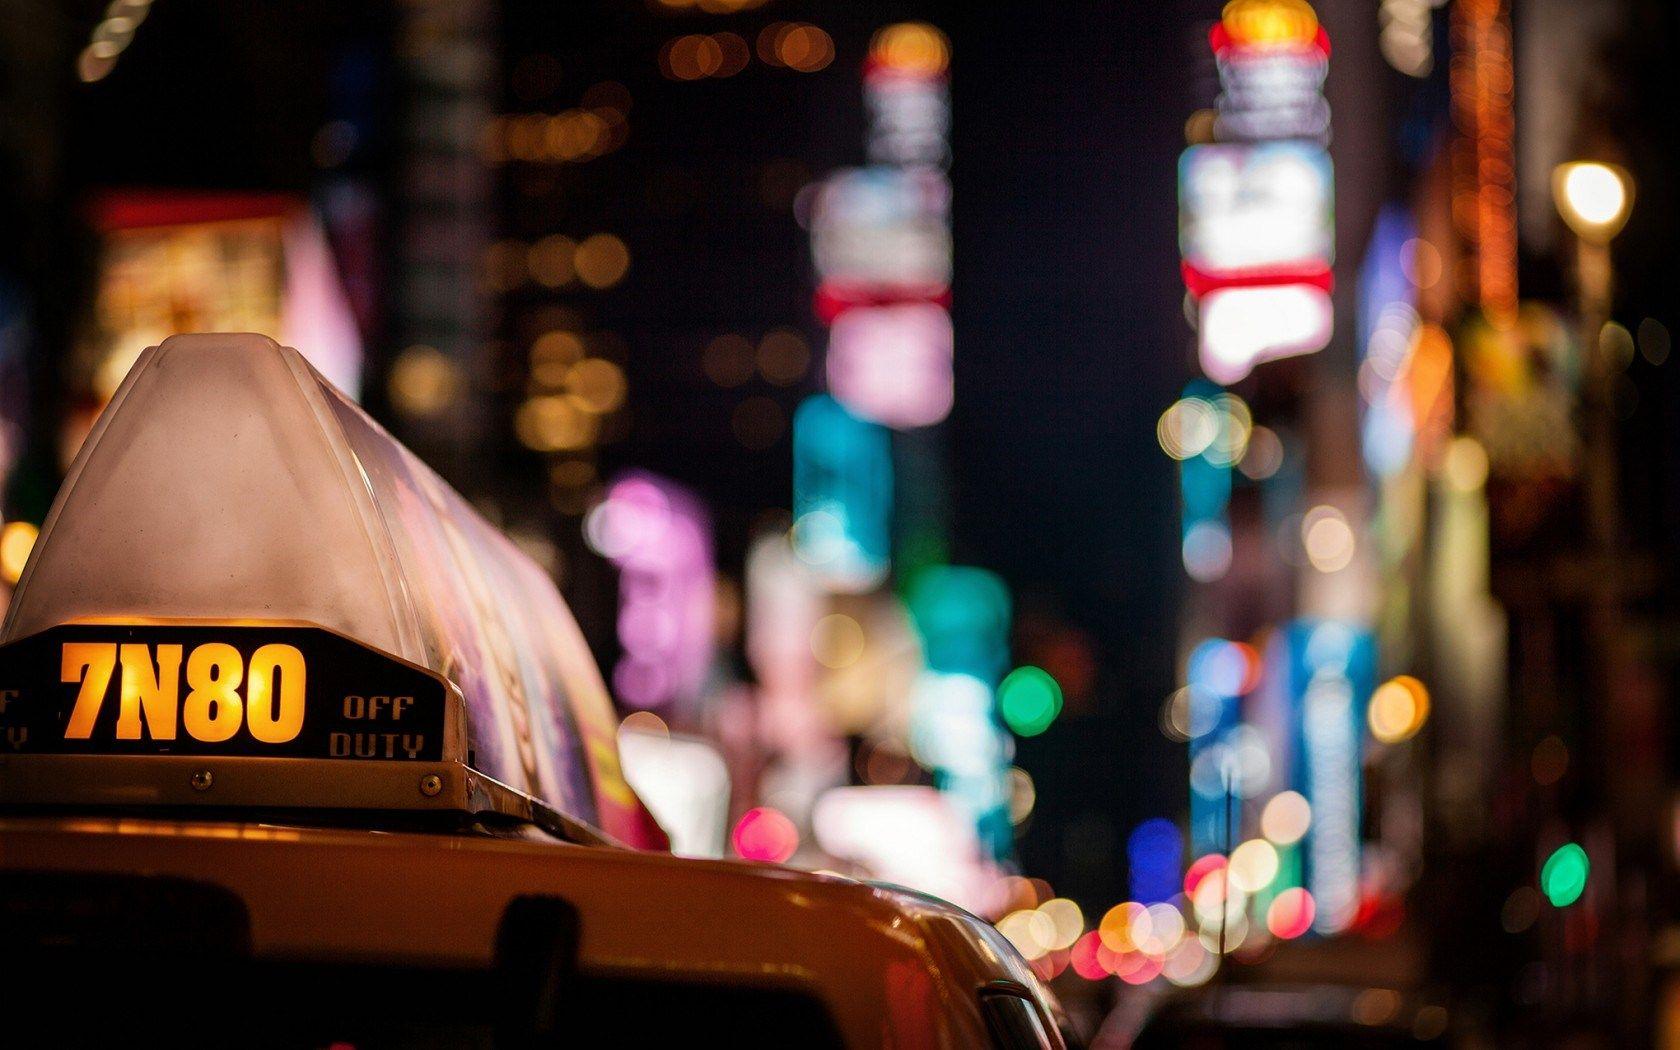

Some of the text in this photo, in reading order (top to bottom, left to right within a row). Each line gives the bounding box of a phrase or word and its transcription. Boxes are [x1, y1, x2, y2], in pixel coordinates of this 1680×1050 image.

[60, 642, 307, 744] 7N80
[343, 695, 414, 721] OFF
[329, 732, 425, 759] DUTY
